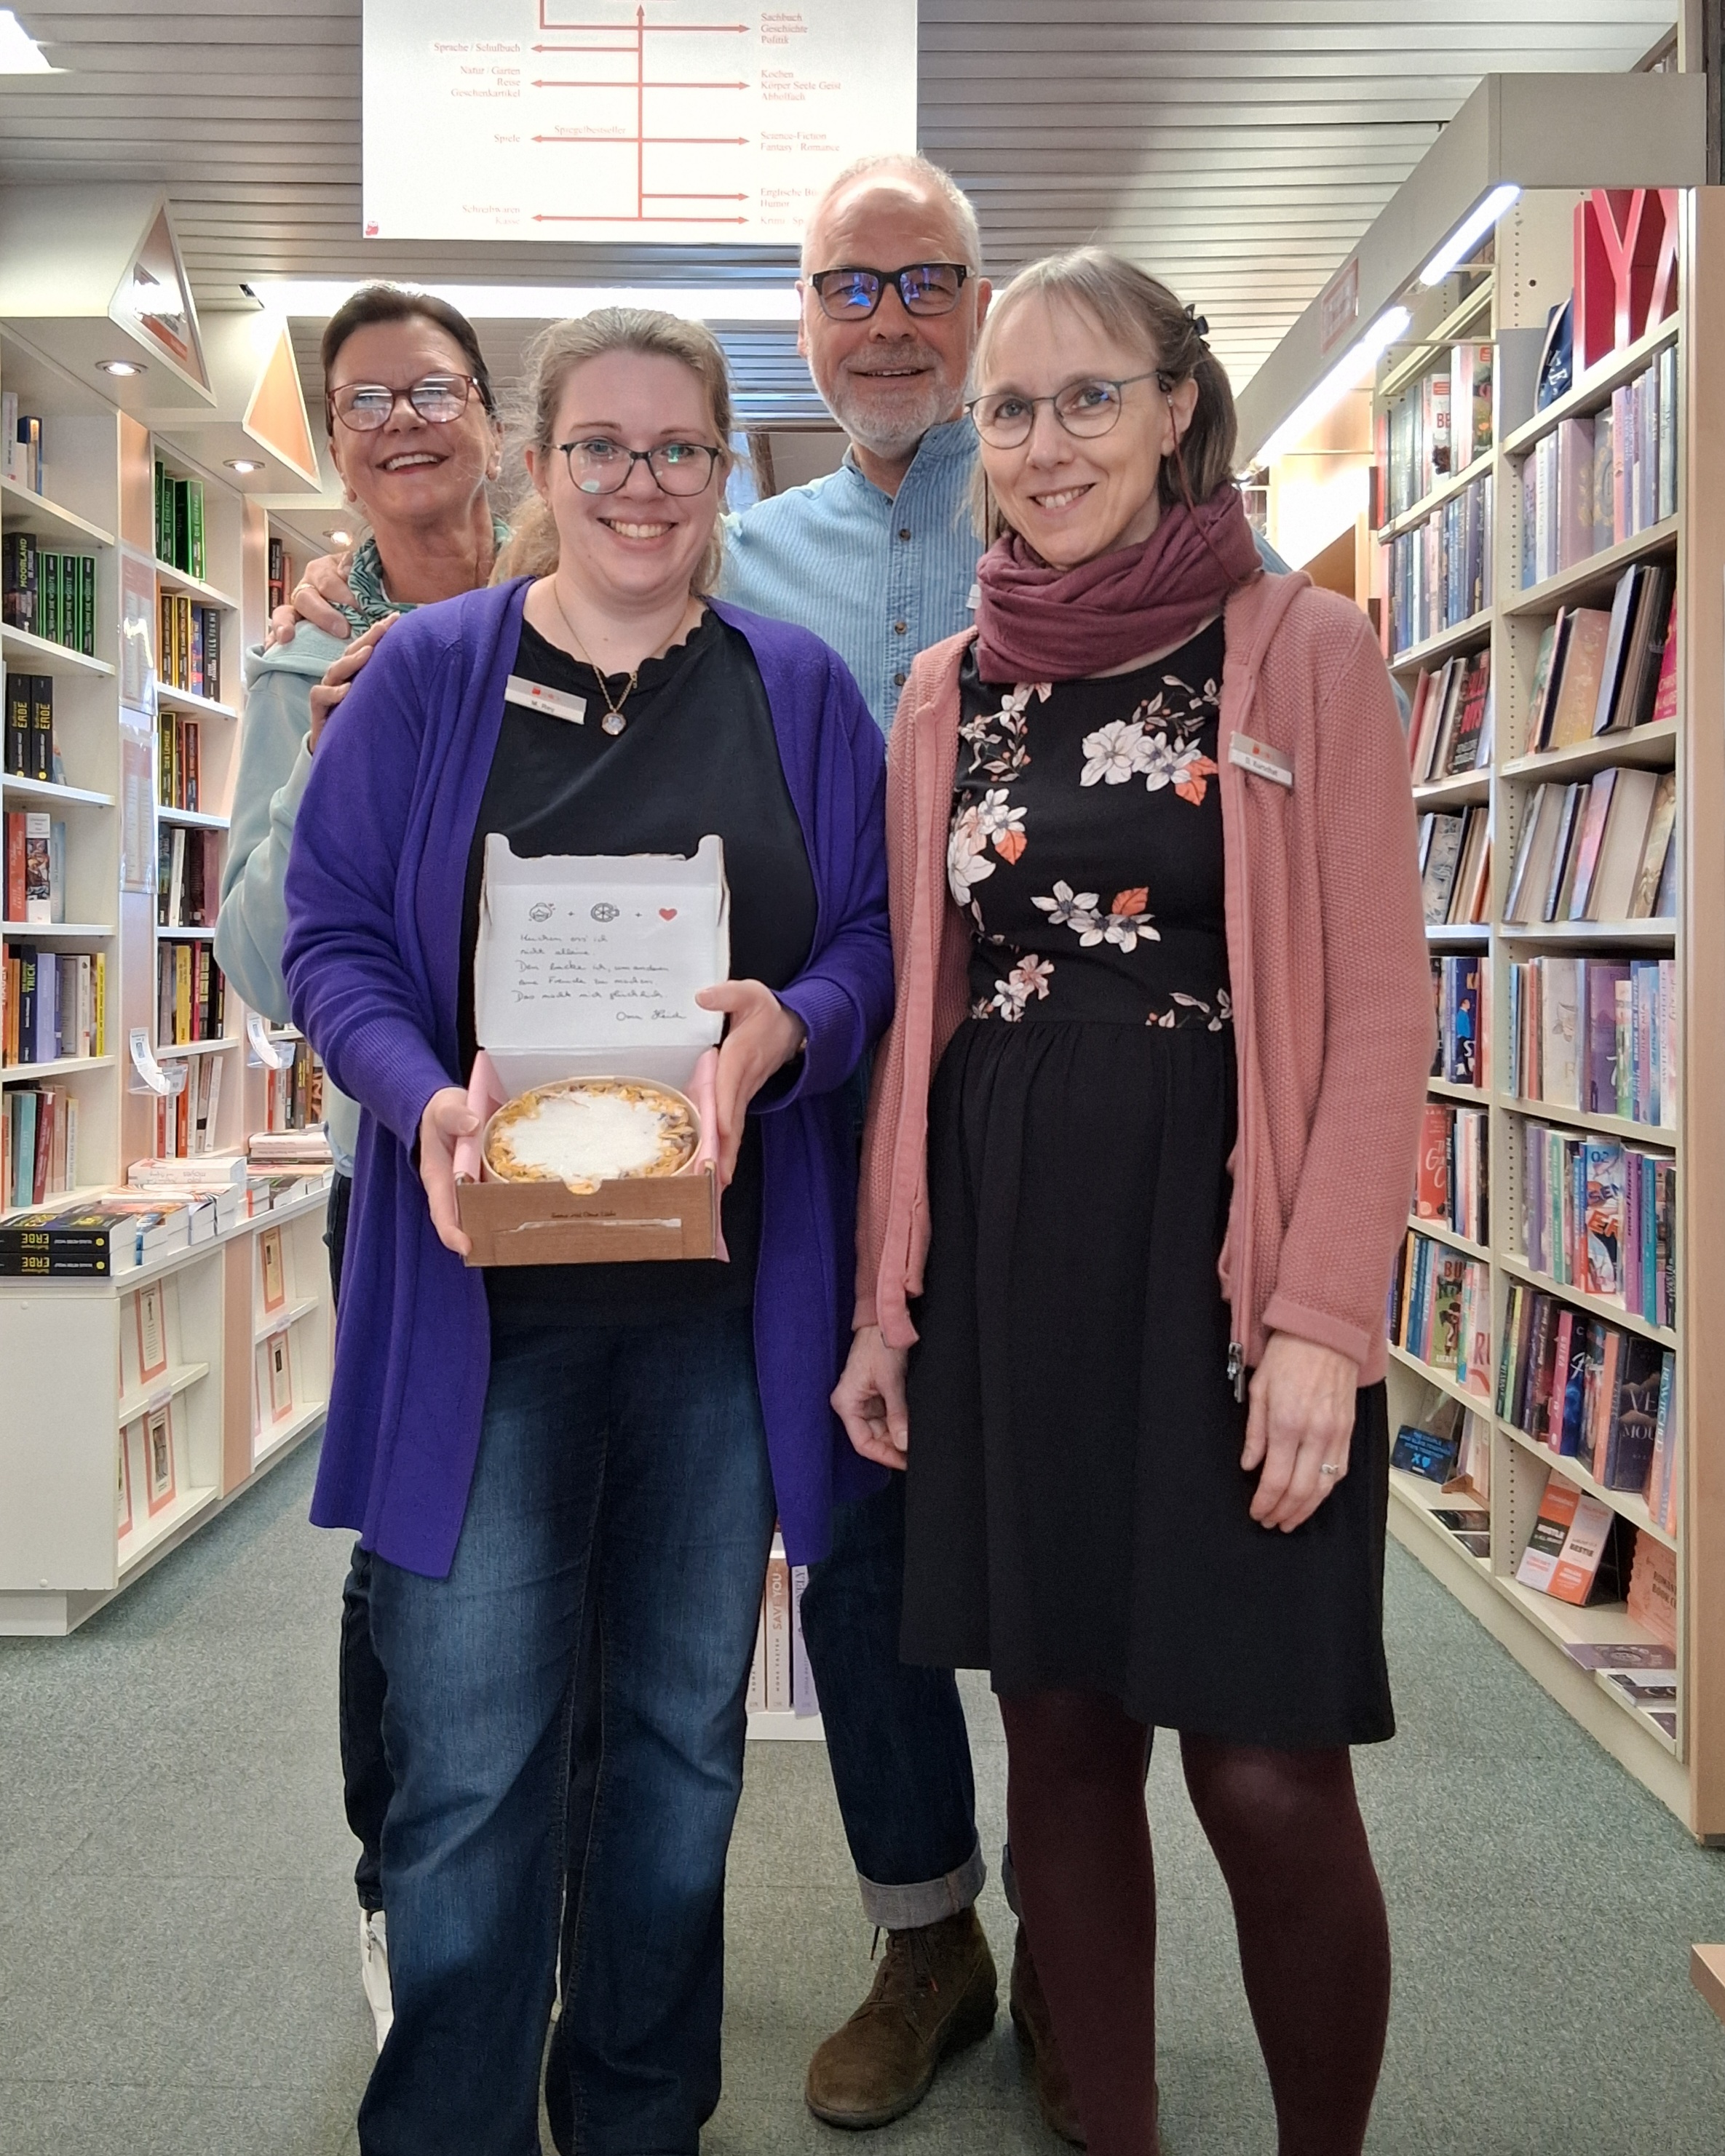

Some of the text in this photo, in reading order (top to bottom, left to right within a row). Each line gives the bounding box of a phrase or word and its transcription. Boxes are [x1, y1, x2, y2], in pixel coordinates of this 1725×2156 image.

[761, 13, 803, 22] Sachbuch
[434, 43, 469, 52] Sprache
[475, 44, 520, 52] Schulbuch
[460, 66, 485, 75] Natur
[491, 67, 520, 75] Garten
[19, 538, 28, 588] MOORLAND
[27, 963, 36, 992] TRICK
[21, 1233, 49, 1244] ERBE
[21, 1257, 50, 1268] ERBE
[772, 1572, 782, 1631] SAVE YOU
